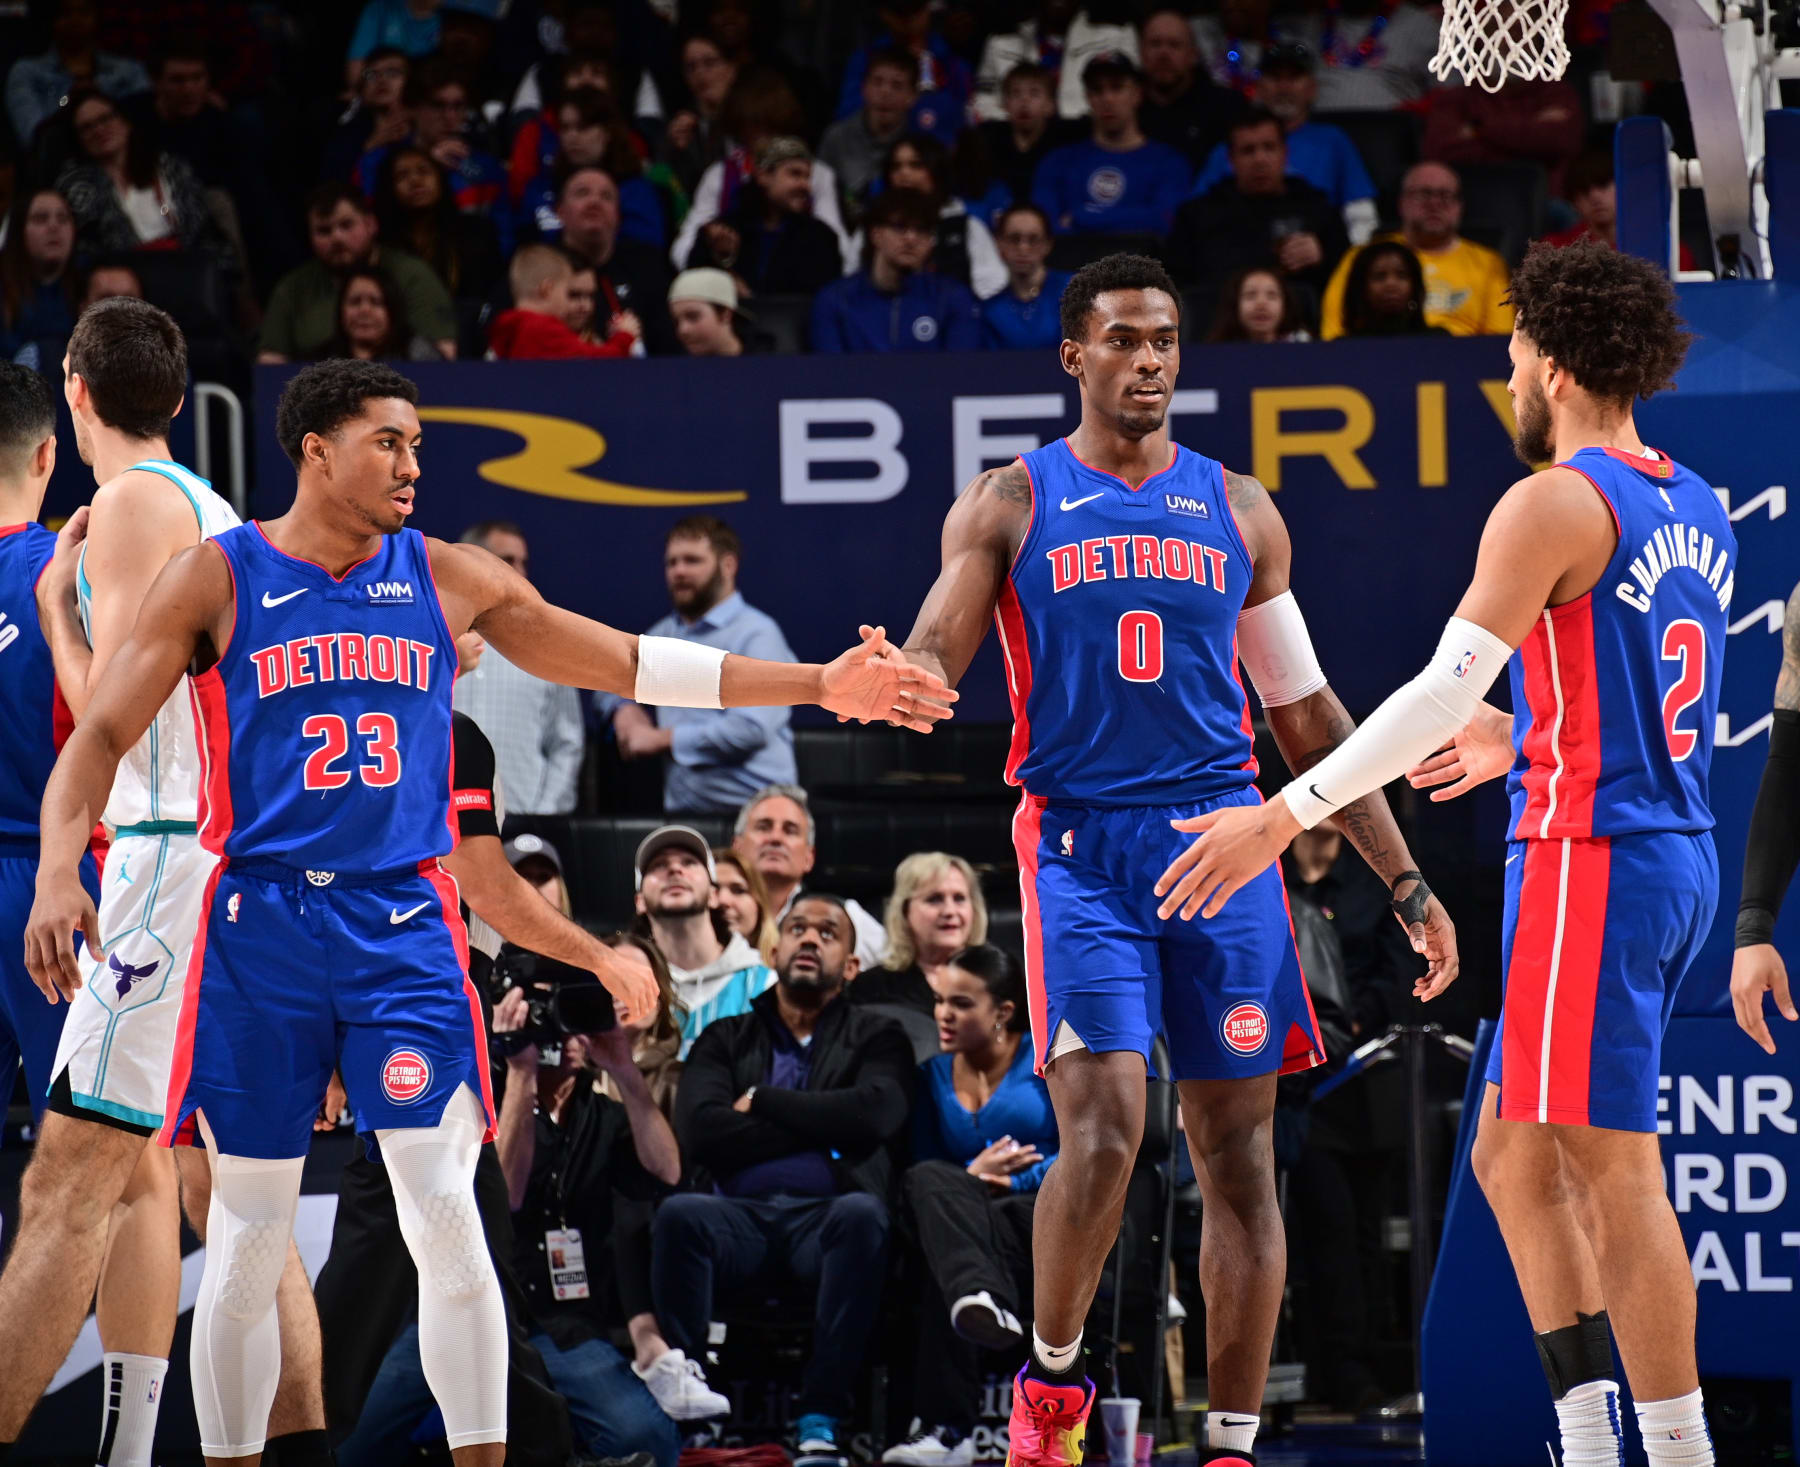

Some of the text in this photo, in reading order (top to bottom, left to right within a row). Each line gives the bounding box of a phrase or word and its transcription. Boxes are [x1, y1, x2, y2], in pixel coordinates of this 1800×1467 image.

[1165, 494, 1208, 514] UWM
[1046, 534, 1228, 594] DETROIT
[1616, 522, 1735, 613] CUNNINGHAM
[366, 581, 413, 598] UWM
[250, 632, 435, 699] DETROIT
[1117, 609, 1164, 684] 0
[1660, 618, 1706, 763] 2
[302, 712, 402, 791] 23
[455, 793, 488, 806] mirates
[1230, 1017, 1261, 1030] DETROIT
[1231, 1026, 1262, 1039] PISTONS
[388, 1066, 422, 1076] DETROIT
[388, 1075, 421, 1085] PISTONS
[1660, 1153, 1787, 1213] RD
